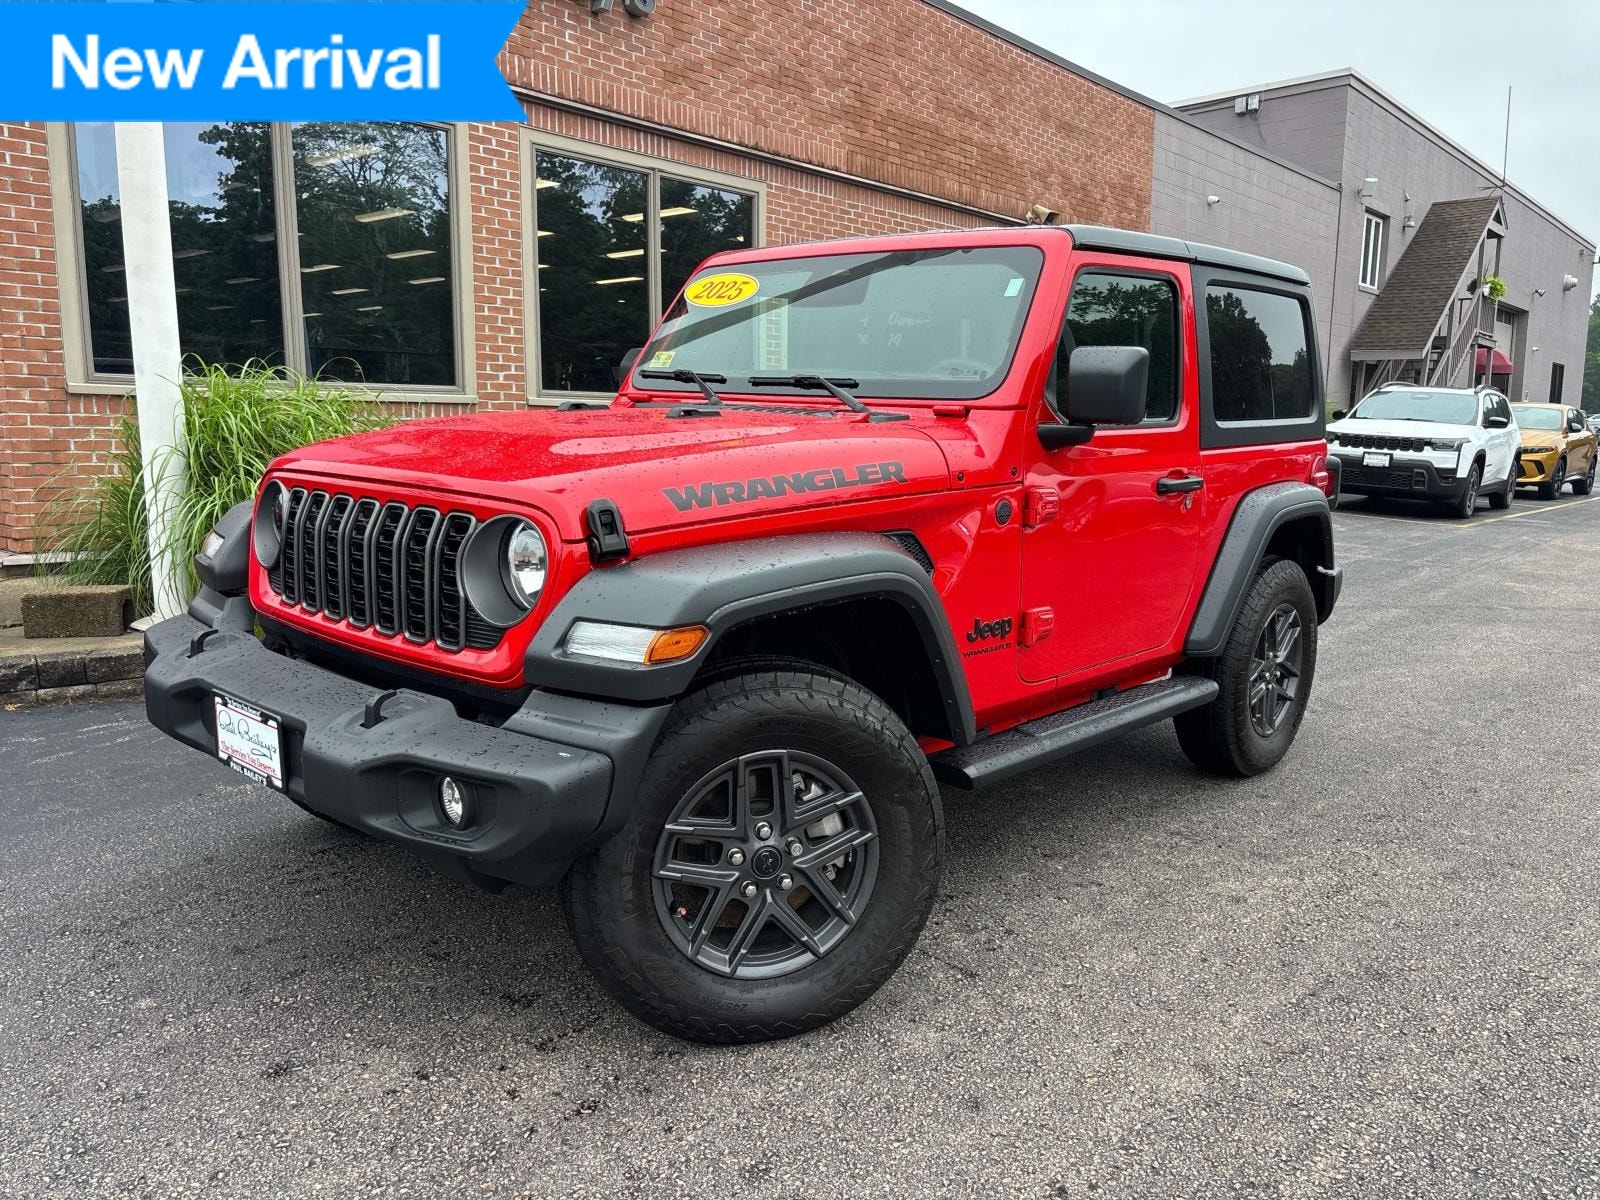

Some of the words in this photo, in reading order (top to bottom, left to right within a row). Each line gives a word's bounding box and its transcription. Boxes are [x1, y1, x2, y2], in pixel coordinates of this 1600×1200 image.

[693, 280, 751, 301] 2025
[661, 460, 909, 513] WRANGLER
[966, 616, 1013, 643] Jeep
[221, 740, 230, 753] The
[230, 744, 248, 761] Service
[247, 752, 257, 766] You
[230, 761, 244, 774] PAUL
[243, 767, 267, 785] BAILEY'S
